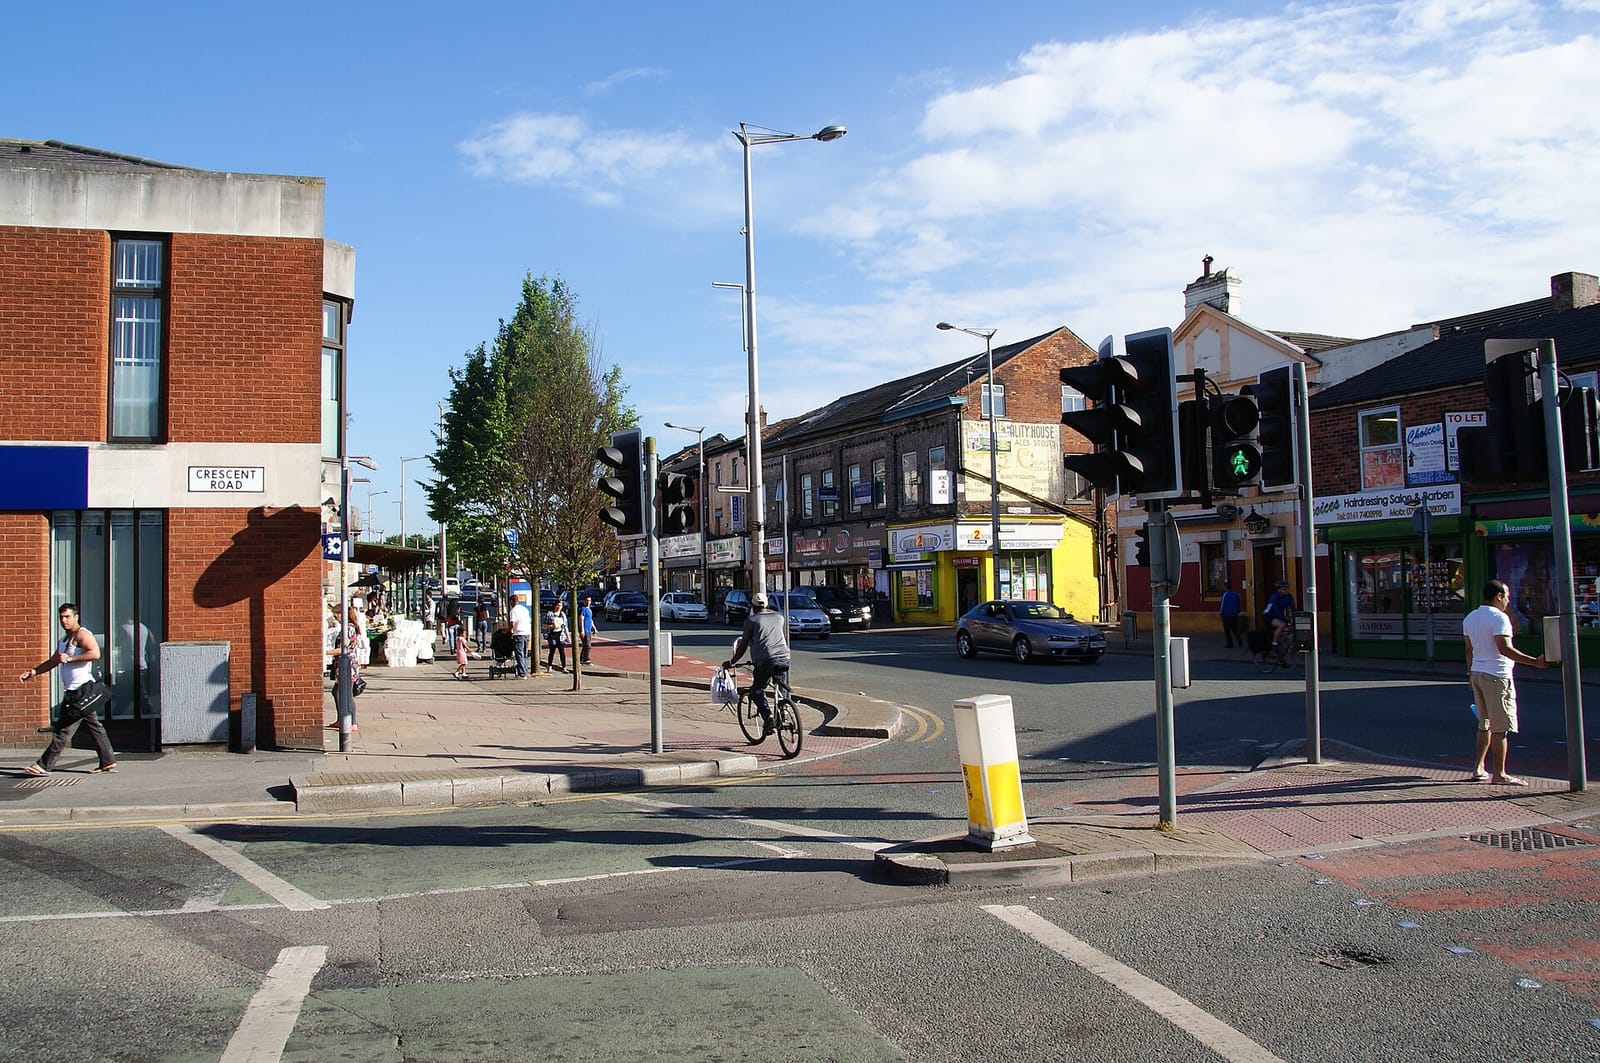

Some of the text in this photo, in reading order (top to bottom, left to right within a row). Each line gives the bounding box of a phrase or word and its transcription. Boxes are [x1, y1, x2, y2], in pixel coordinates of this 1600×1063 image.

[1448, 414, 1483, 422] TO LET
[1010, 424, 1054, 439] ALITY HOUSE
[1407, 424, 1441, 444] Choices
[196, 469, 256, 479] CRESCENT
[210, 480, 243, 489] ROAD
[1313, 499, 1340, 516] oices
[1343, 496, 1389, 508] Hairdressing
[1414, 493, 1421, 502] &
[1422, 490, 1455, 503] Barbers
[974, 530, 980, 539] 2
[917, 535, 923, 547] 2
